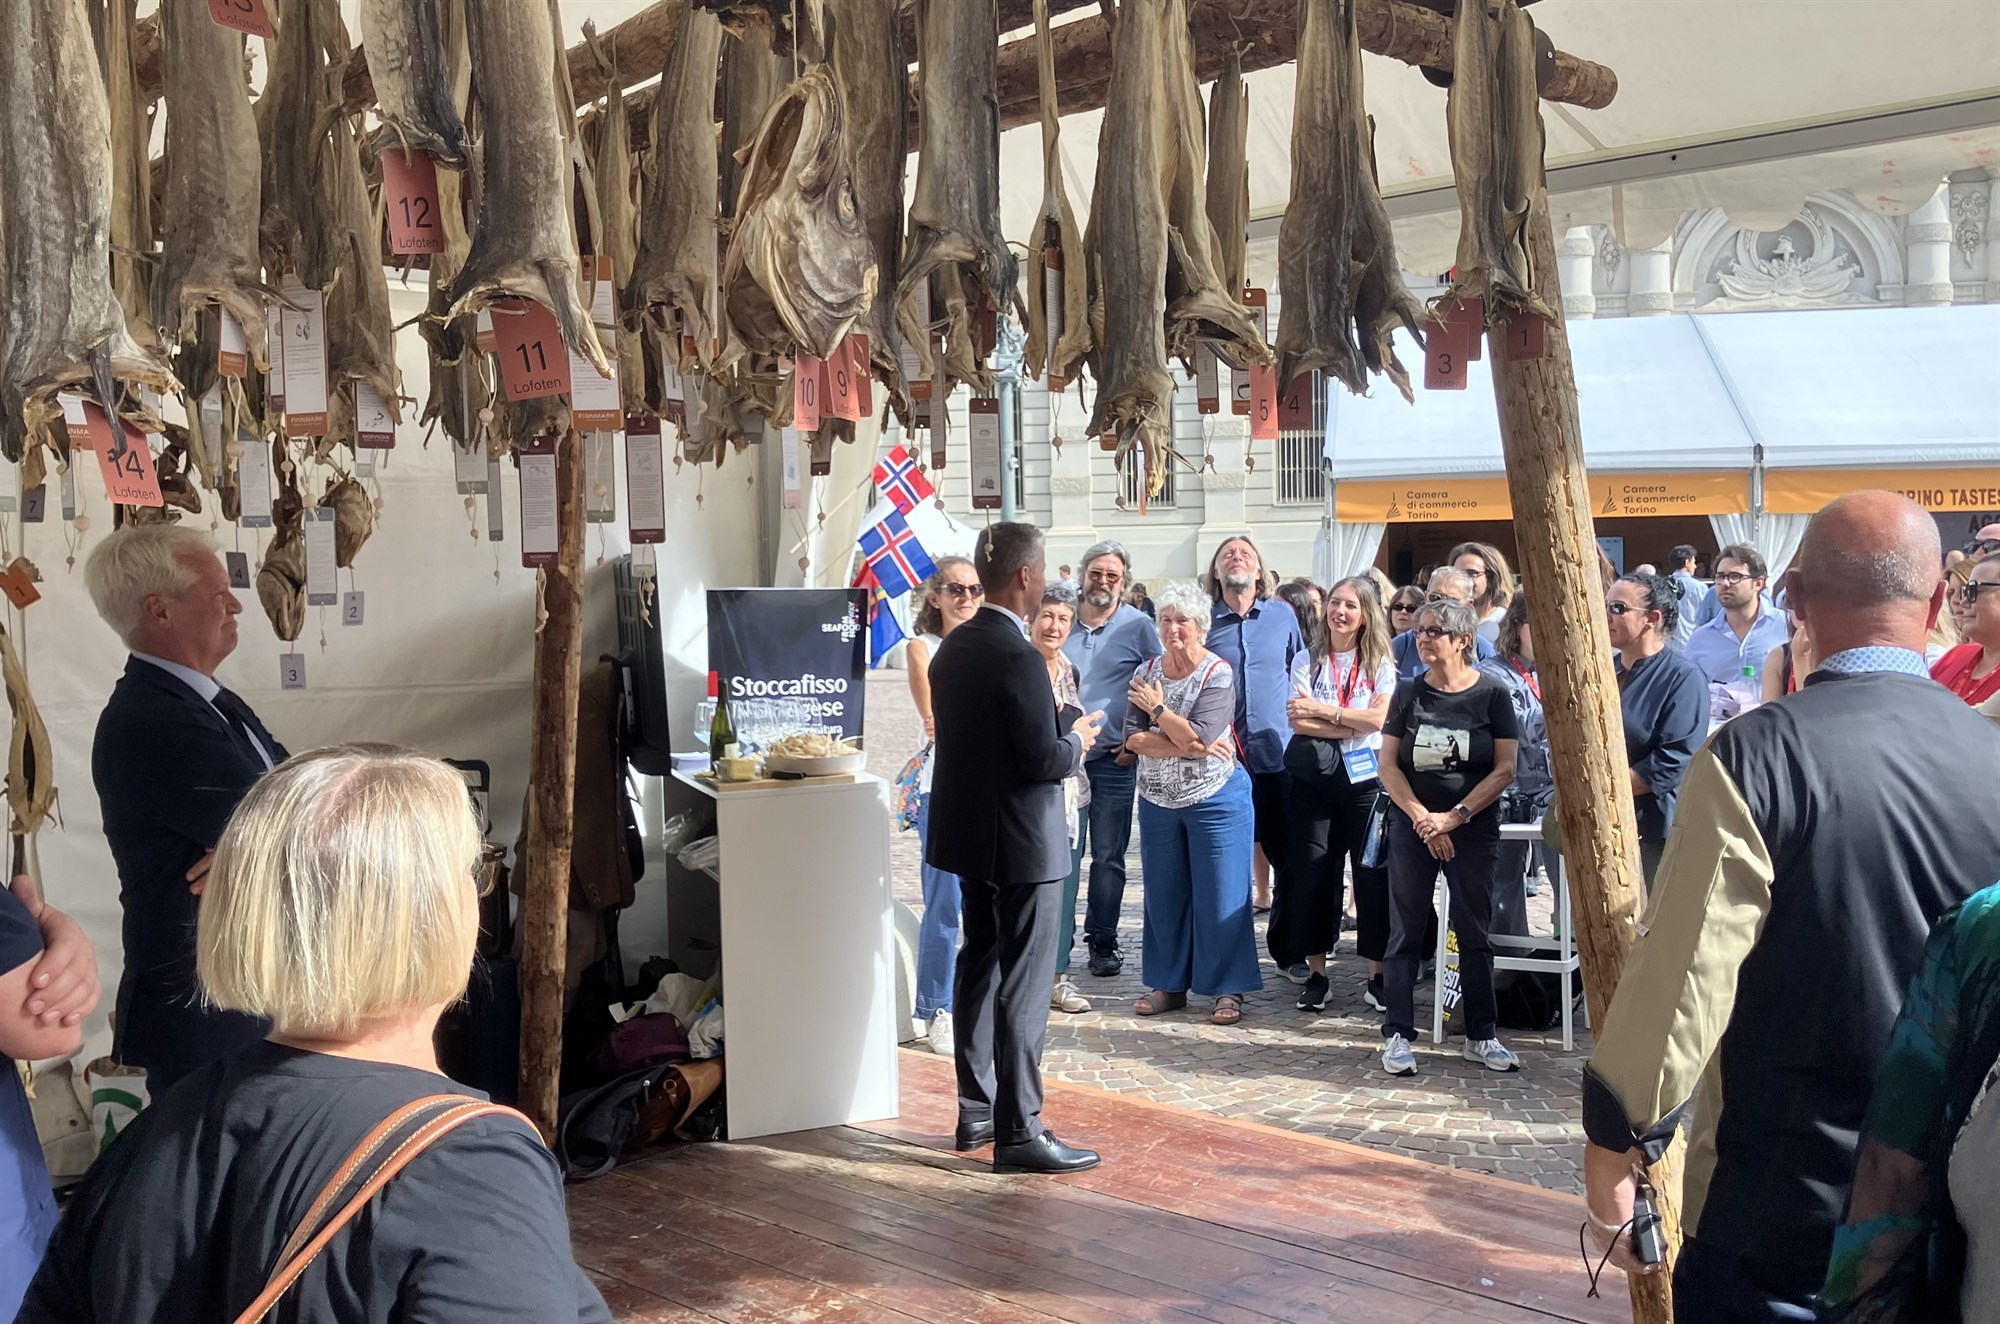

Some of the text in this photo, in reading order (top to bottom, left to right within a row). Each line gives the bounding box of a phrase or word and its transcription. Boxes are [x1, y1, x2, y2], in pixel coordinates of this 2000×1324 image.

[218, 11, 266, 33] Lofoten
[399, 196, 433, 228] 12
[399, 236, 439, 249] Lofoten
[1520, 328, 1528, 347] 1
[515, 340, 547, 373] 11
[1438, 353, 1452, 375] 3
[513, 378, 562, 394] Lofoten
[837, 370, 848, 398] 9
[1429, 379, 1462, 389] Lofoten
[800, 378, 815, 407] 10
[1259, 399, 1269, 421] 5
[1288, 394, 1300, 415] 4
[290, 416, 323, 424] FINNMARK
[107, 447, 145, 480] 14
[113, 486, 156, 500] Lofoten
[1406, 491, 1448, 499] Camera
[1623, 485, 1666, 494] Camera
[1623, 494, 1696, 504] di commercio
[1888, 489, 1944, 506] RINO
[29, 500, 37, 513] 7
[1406, 500, 1477, 509] di commercio
[1623, 506, 1657, 514] Torino
[1406, 511, 1439, 519] Torino
[235, 568, 243, 580] 4
[15, 585, 25, 597] 1
[349, 606, 358, 618] 2
[821, 623, 861, 632] SEAFOOD
[288, 669, 298, 682] 3
[731, 673, 848, 696] Stoccafisso
